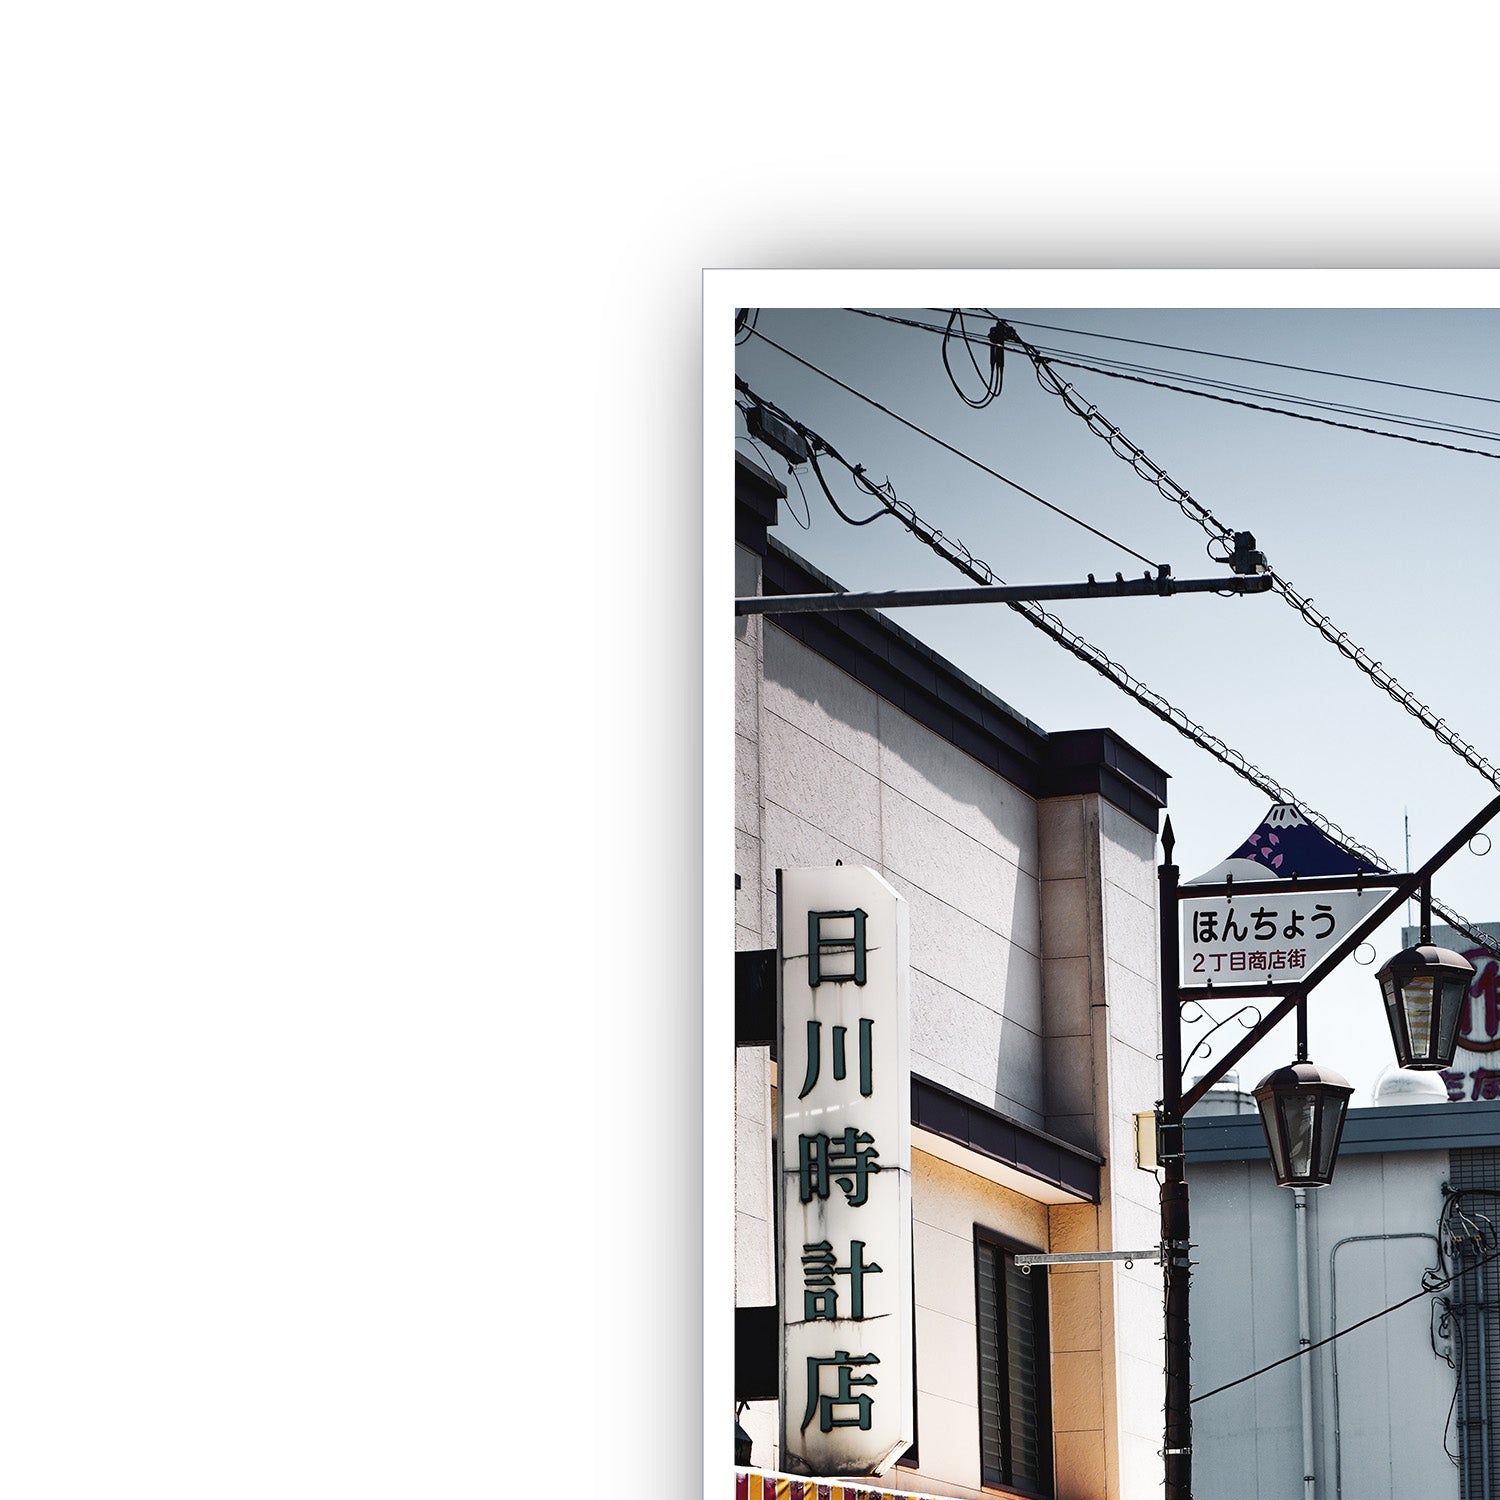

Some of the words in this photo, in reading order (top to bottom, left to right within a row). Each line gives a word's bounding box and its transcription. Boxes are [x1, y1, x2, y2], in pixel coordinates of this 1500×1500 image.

[1192, 904, 1336, 943] ほんちょう
[1192, 948, 1307, 972] 2丁目商店街
[798, 908, 882, 1433] 日川時計店
